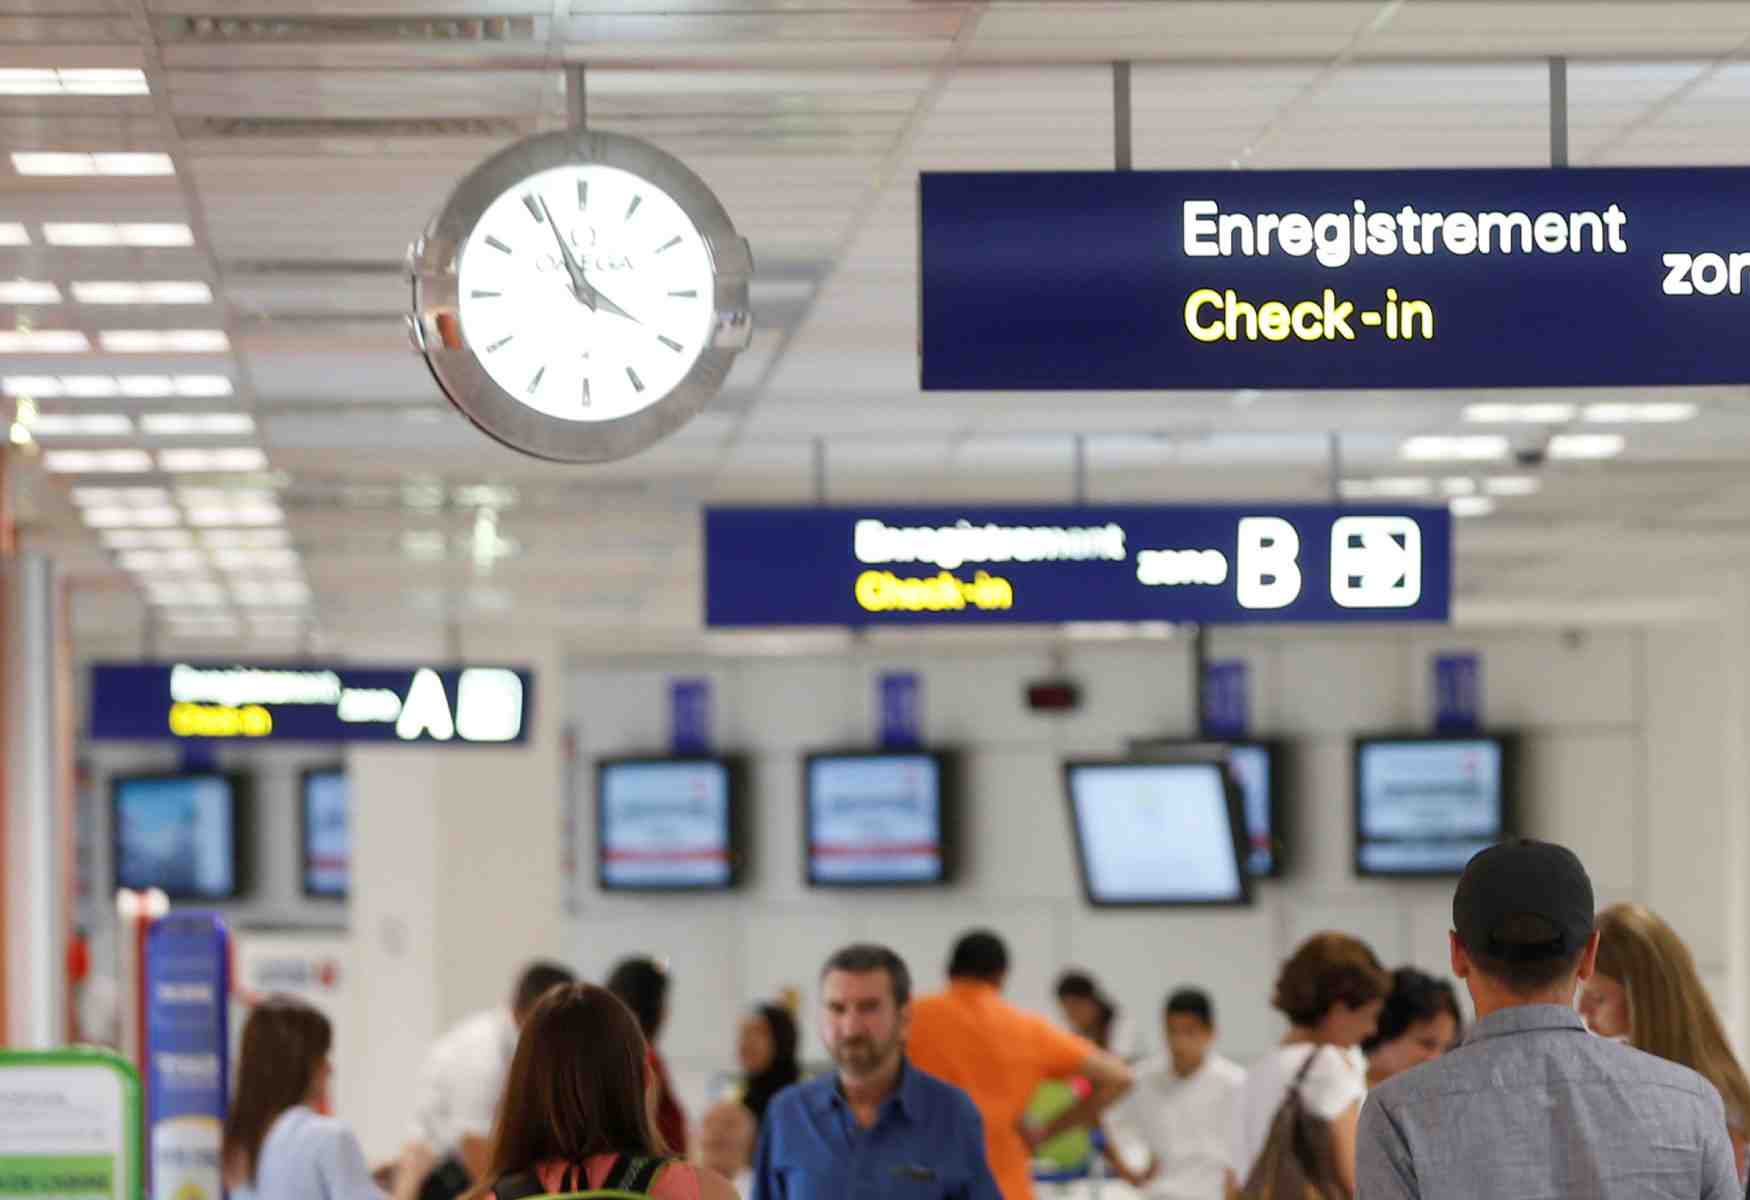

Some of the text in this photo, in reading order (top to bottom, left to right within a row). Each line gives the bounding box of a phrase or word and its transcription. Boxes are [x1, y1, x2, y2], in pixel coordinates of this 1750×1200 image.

[1183, 199, 1628, 268] Enregistrement
[1184, 288, 1434, 341] Check-in
[1237, 516, 1302, 610] B
[396, 667, 455, 741] A
